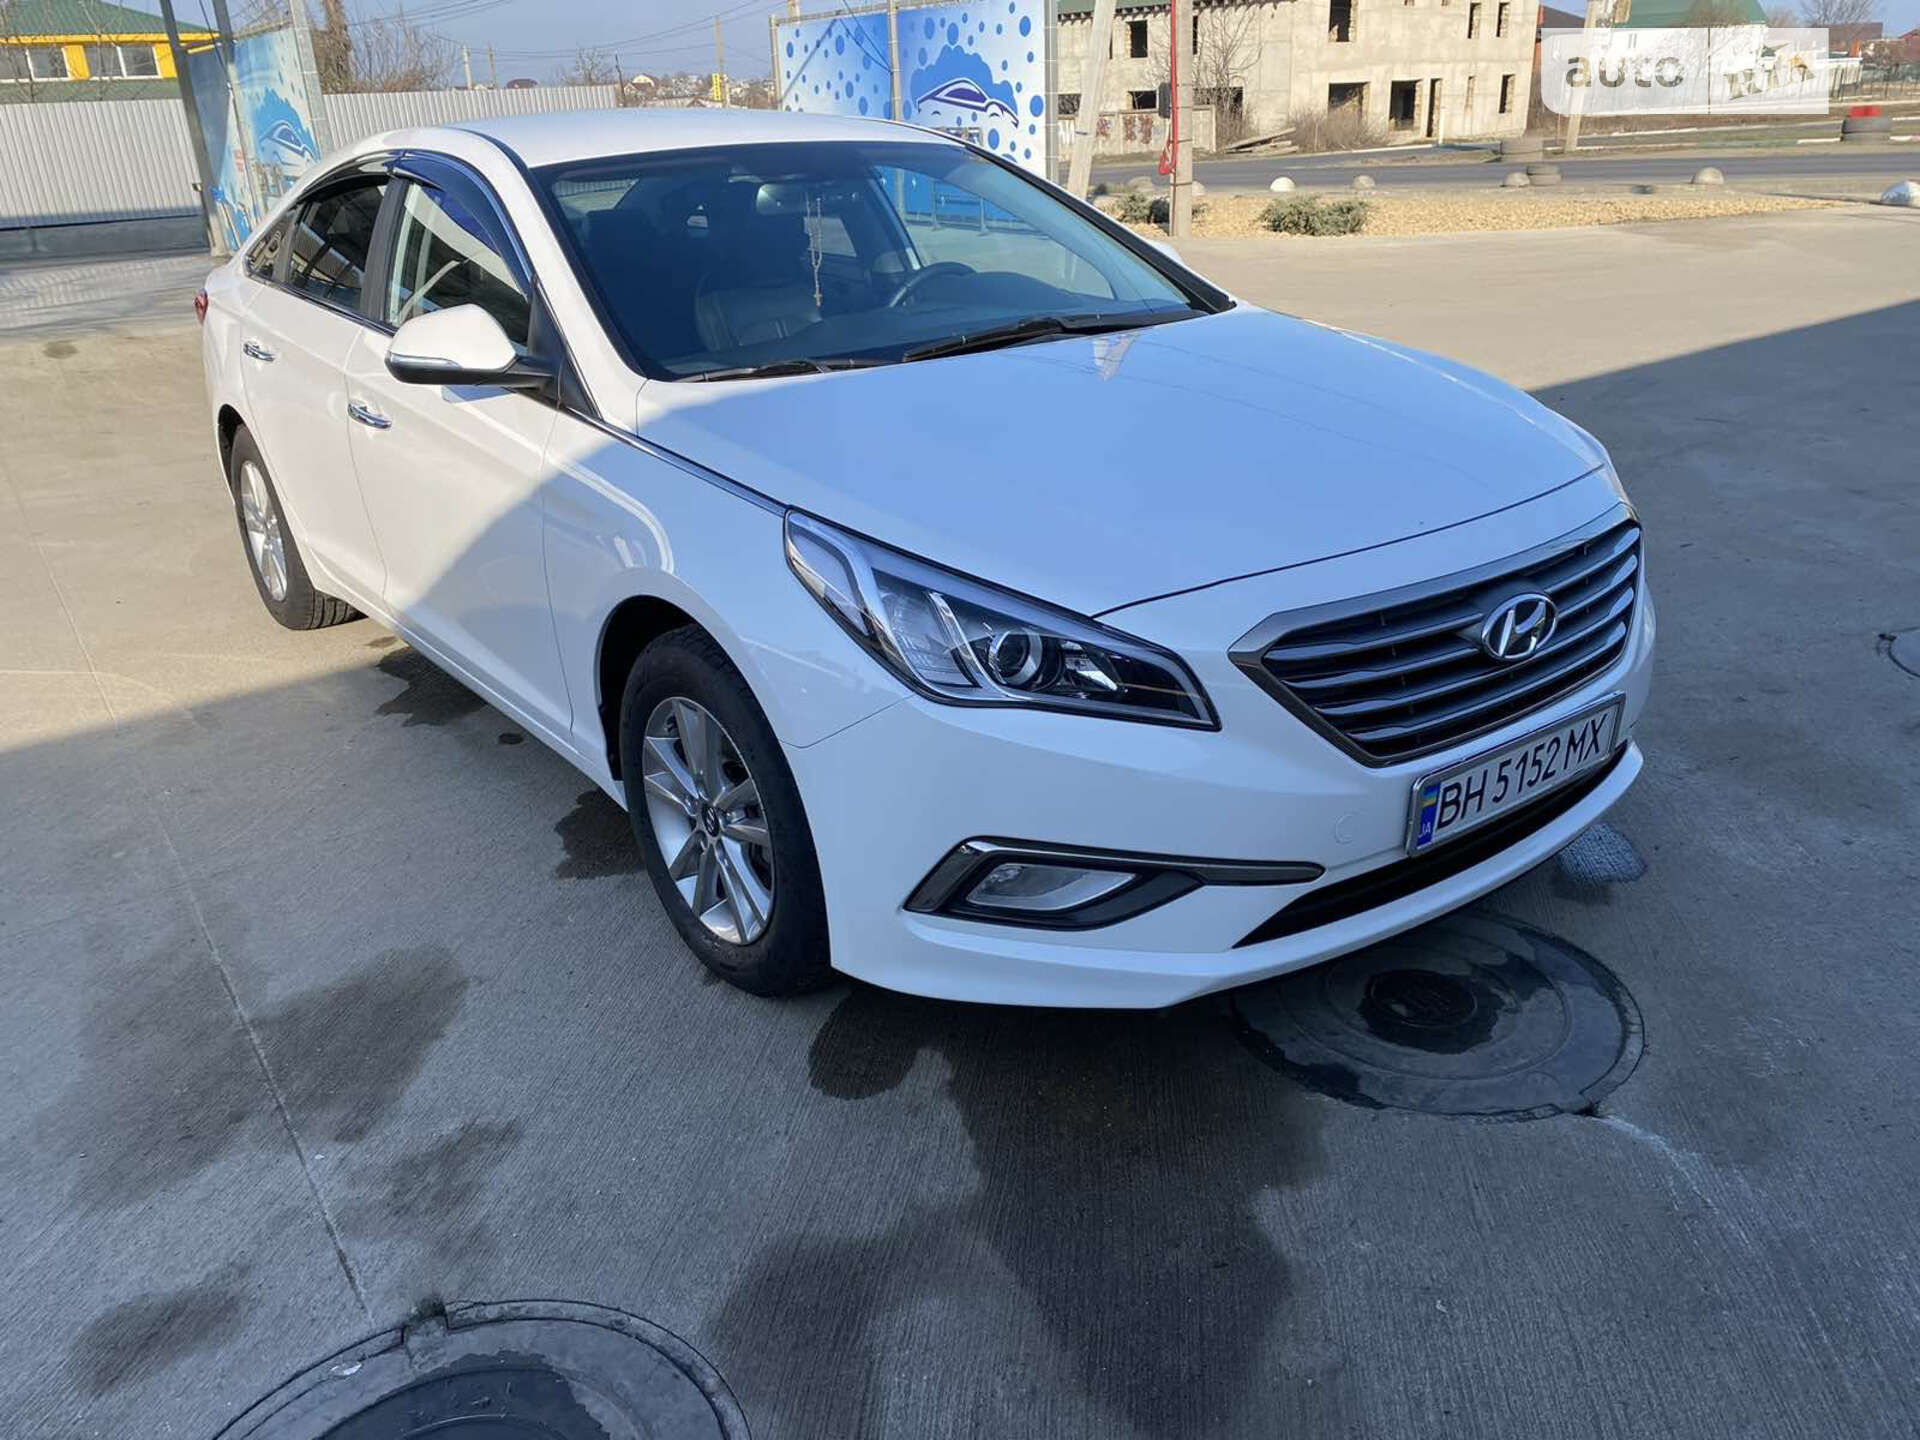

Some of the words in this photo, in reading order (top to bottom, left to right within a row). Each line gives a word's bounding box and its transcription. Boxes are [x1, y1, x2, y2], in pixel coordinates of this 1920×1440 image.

[1437, 770, 1488, 829] BH
[1492, 737, 1561, 804] 5152
[1564, 714, 1607, 770] MX
